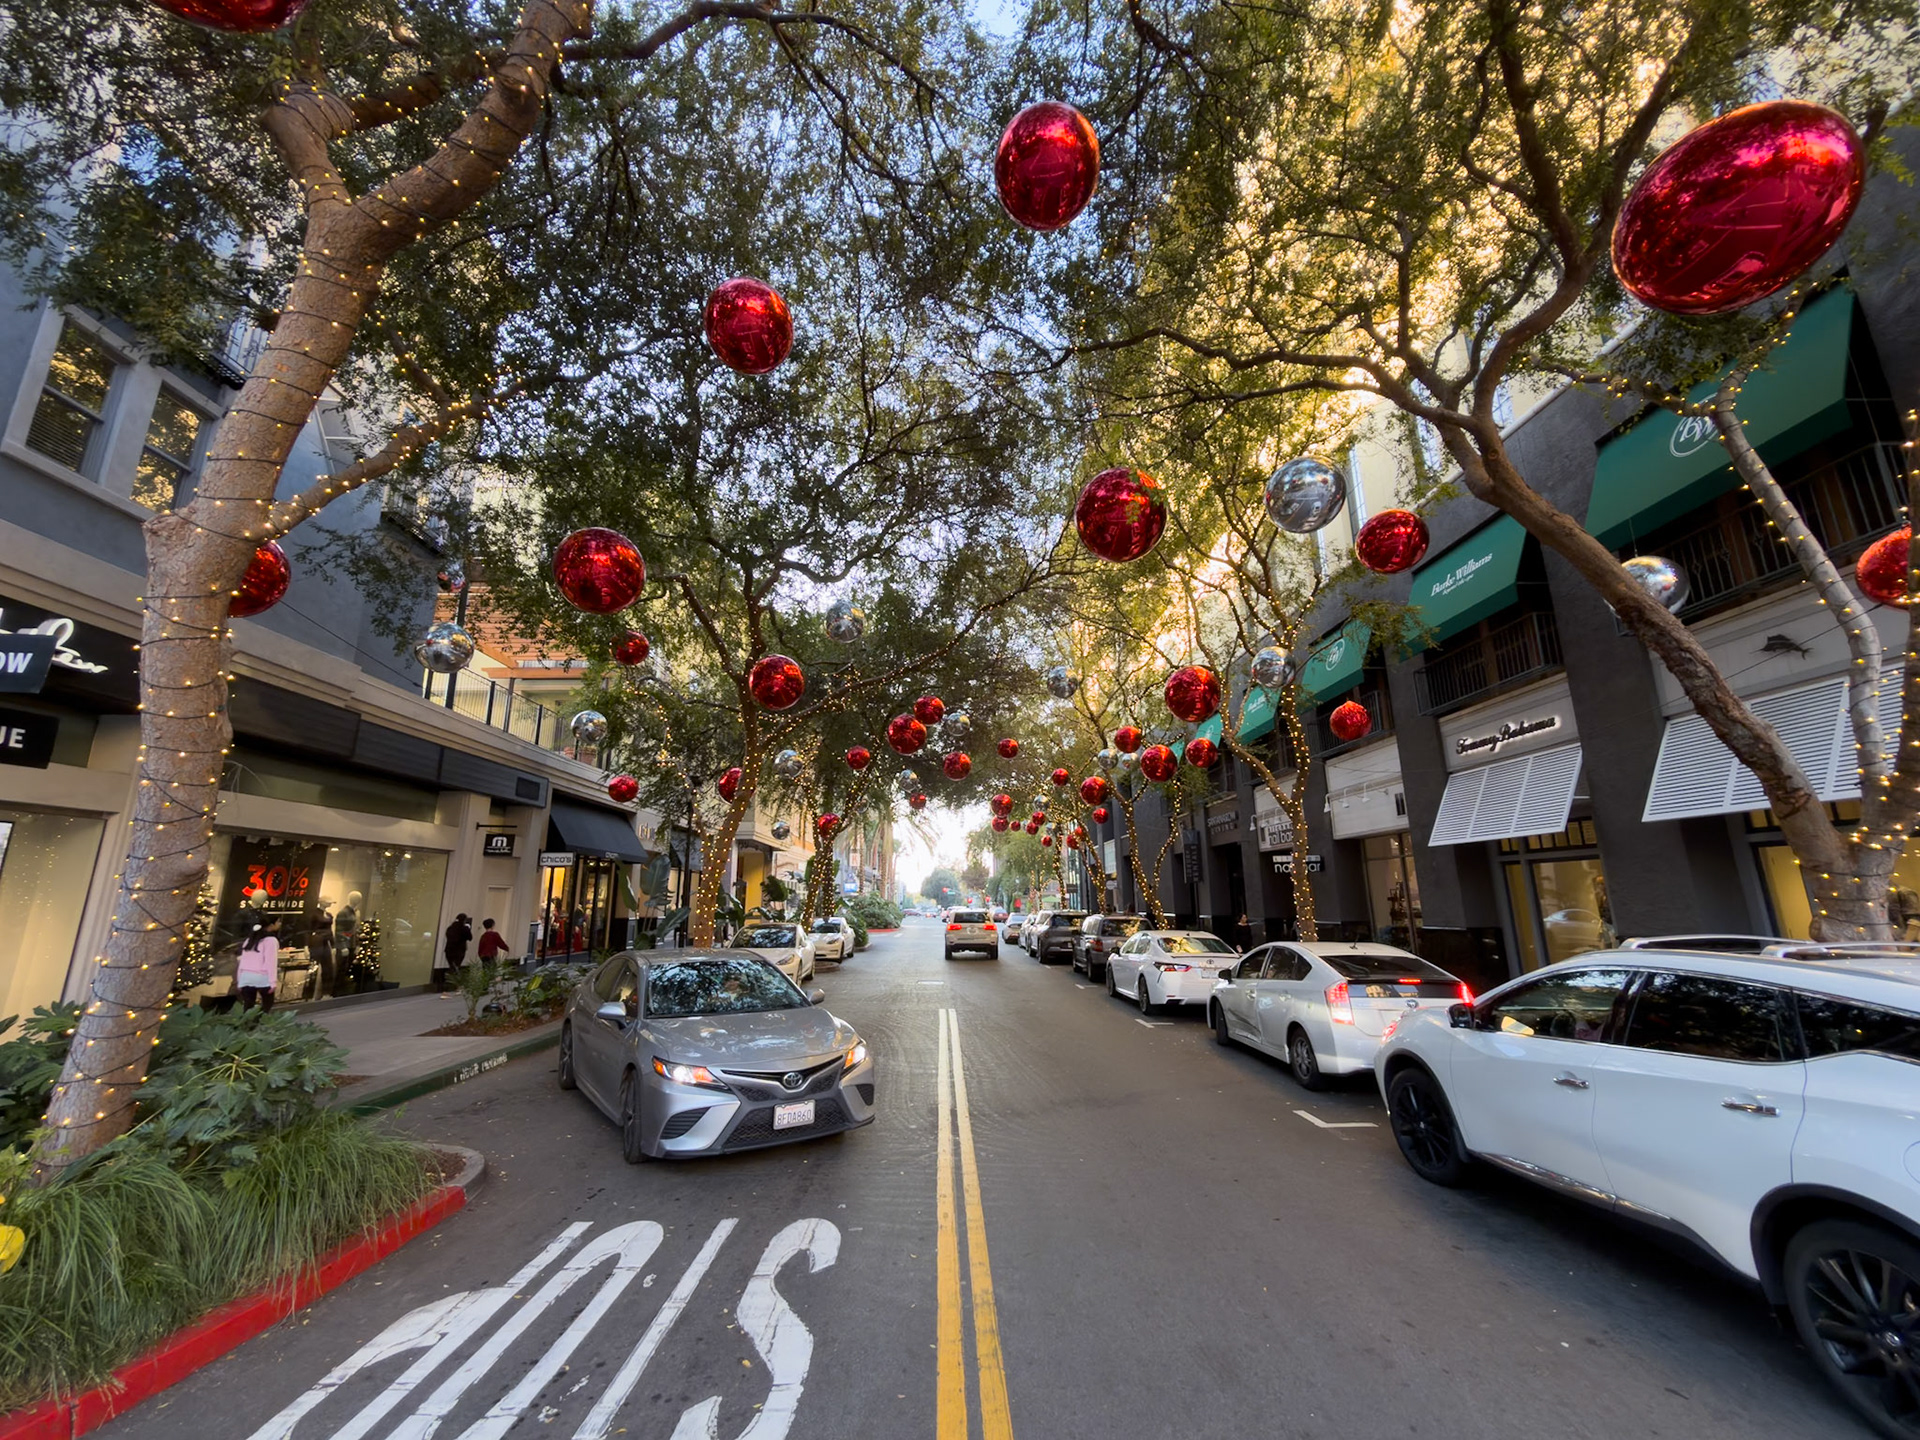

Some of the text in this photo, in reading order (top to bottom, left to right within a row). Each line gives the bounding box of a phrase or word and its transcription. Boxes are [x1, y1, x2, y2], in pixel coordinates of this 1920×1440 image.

[1456, 716, 1557, 755] Tommy Bahama
[540, 855, 572, 864] chico's
[241, 864, 309, 897] 30%
[240, 899, 305, 909] SREWIDE
